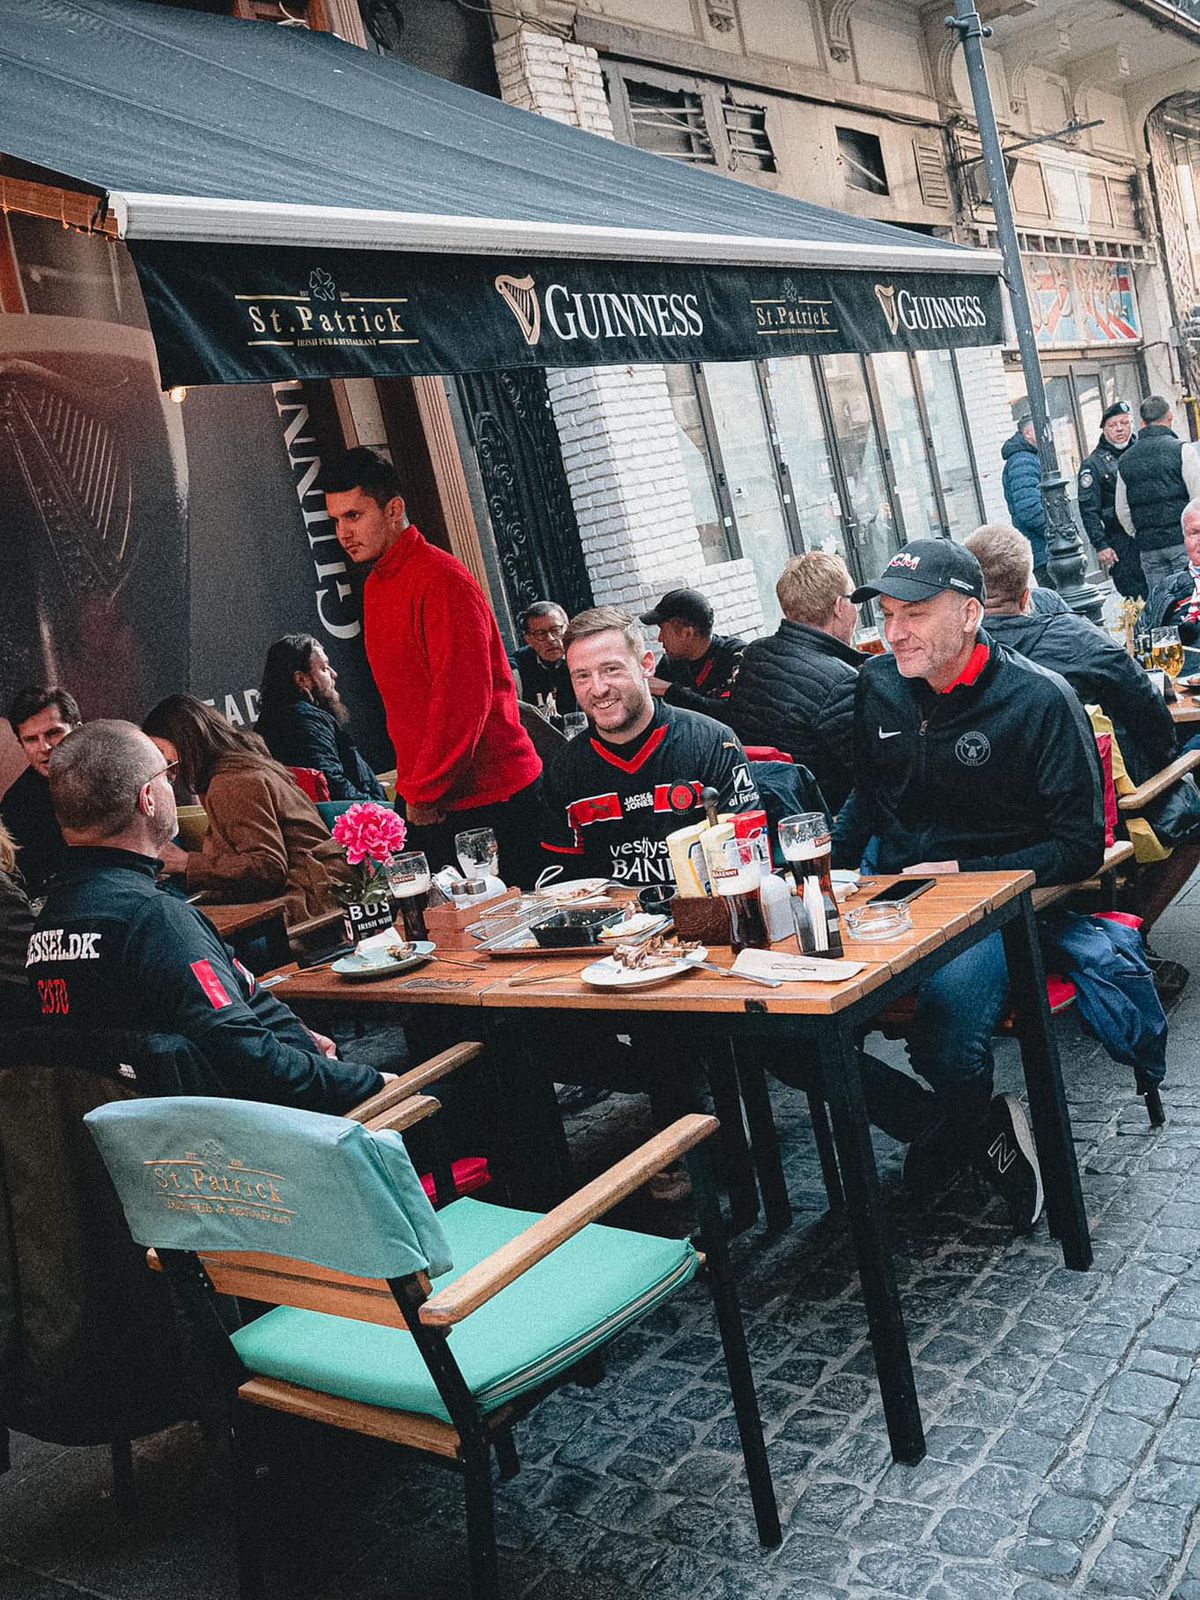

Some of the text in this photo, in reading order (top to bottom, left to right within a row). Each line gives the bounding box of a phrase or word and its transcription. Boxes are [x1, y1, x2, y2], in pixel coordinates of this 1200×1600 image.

[545, 284, 704, 340] GUINNESS
[897, 290, 986, 330] GUINNESS
[357, 919, 378, 931] IRISH
